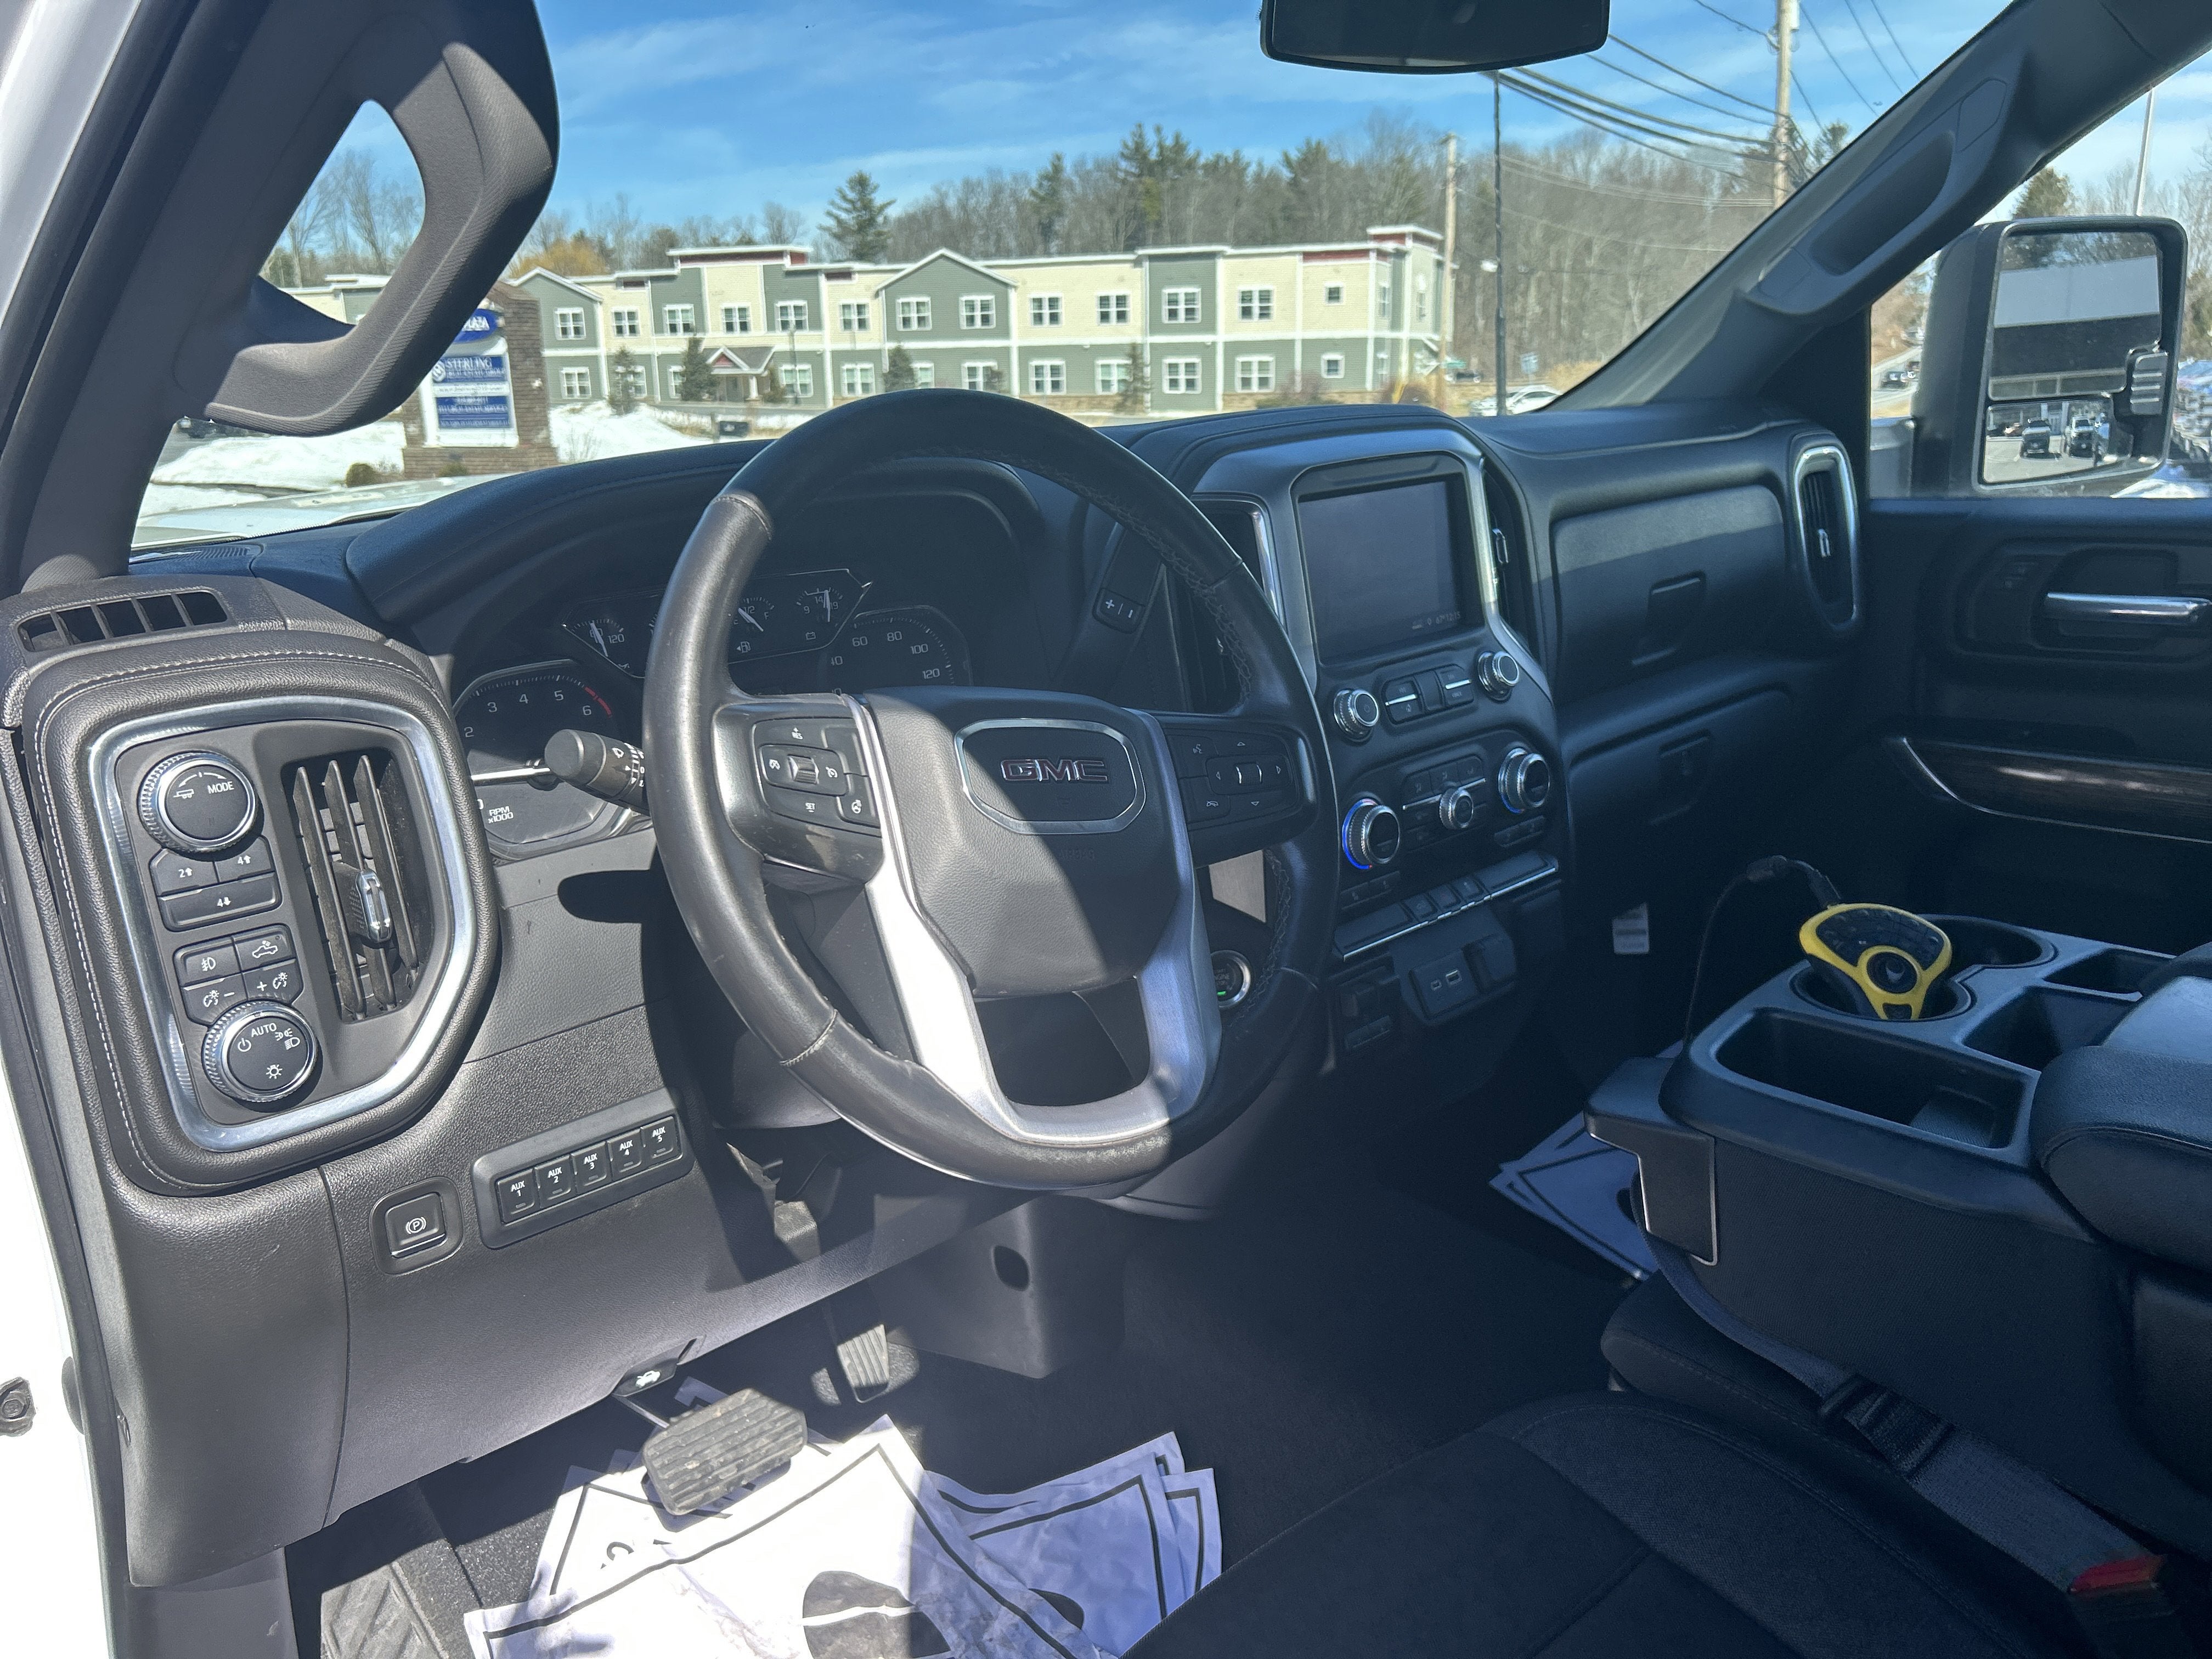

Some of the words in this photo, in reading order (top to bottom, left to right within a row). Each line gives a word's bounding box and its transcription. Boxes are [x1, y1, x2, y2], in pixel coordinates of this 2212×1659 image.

[445, 357, 492, 370] STERLING
[607, 633, 625, 644] 120
[852, 636, 868, 647] 60
[887, 631, 902, 641] 80
[910, 644, 929, 654] 100
[922, 668, 940, 679] 120
[519, 693, 529, 704] 4
[554, 690, 565, 701] 5
[487, 702, 498, 713] 3
[582, 705, 592, 716] 6
[464, 726, 474, 738] 2
[1000, 758, 1109, 782] GMC
[207, 781, 235, 794] MODE
[489, 805, 510, 816] RPM
[488, 811, 514, 824] x1000
[237, 856, 244, 865] 4
[178, 868, 186, 878] 2
[217, 898, 224, 907] 4
[251, 1023, 277, 1037] AUTO
[652, 1126, 665, 1137] AUX
[658, 1135, 663, 1143] 5
[619, 1140, 633, 1151] AUX
[583, 1153, 597, 1165] AUX
[548, 1166, 562, 1178] AUX
[511, 1180, 526, 1192] AUX
